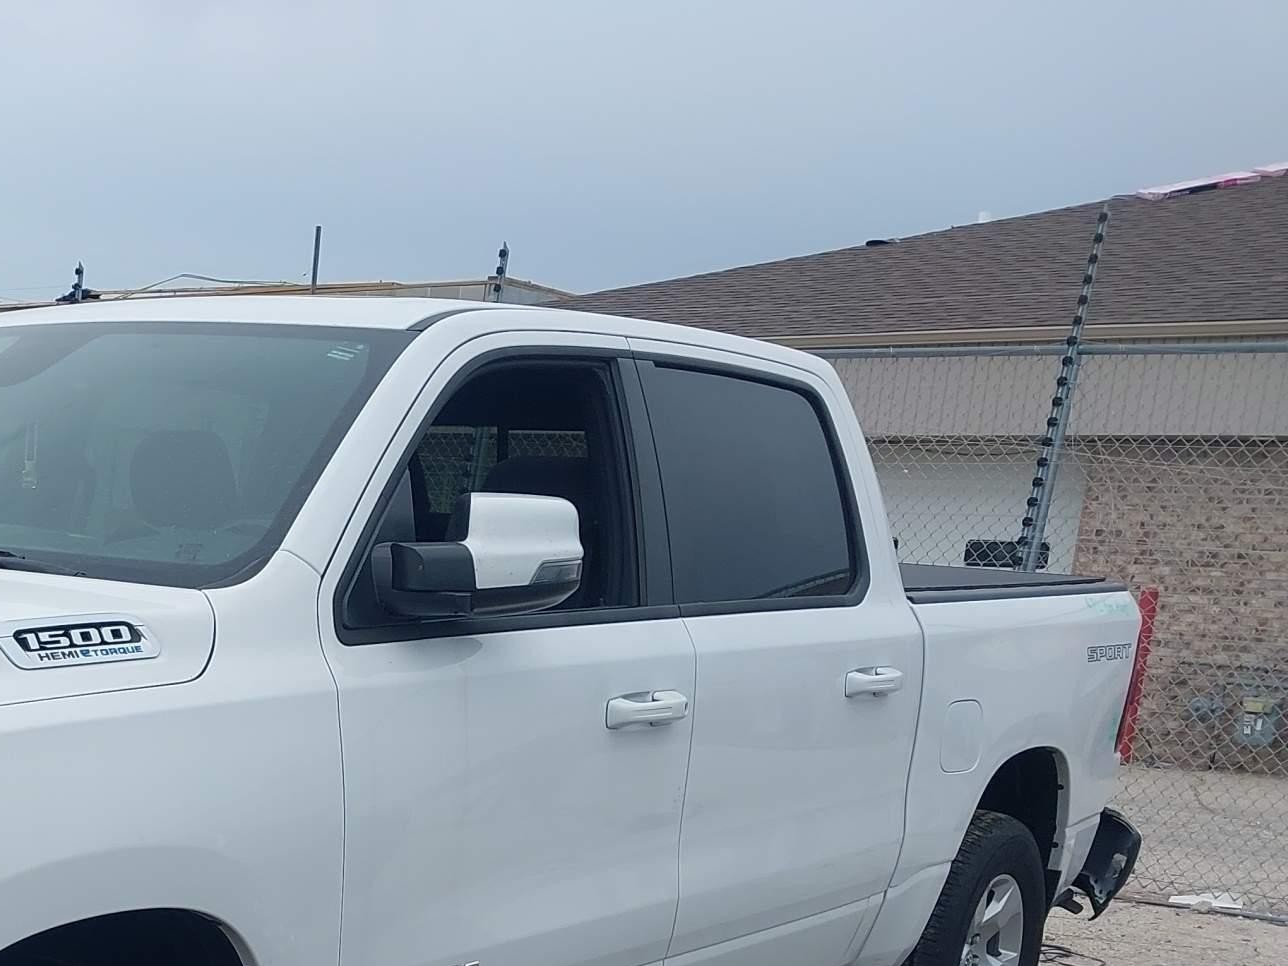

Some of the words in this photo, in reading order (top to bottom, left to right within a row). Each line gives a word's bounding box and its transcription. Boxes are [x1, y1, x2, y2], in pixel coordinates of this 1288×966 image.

[17, 625, 132, 650] 1500
[38, 649, 80, 662] HEMI
[1087, 643, 1132, 662] SPORT
